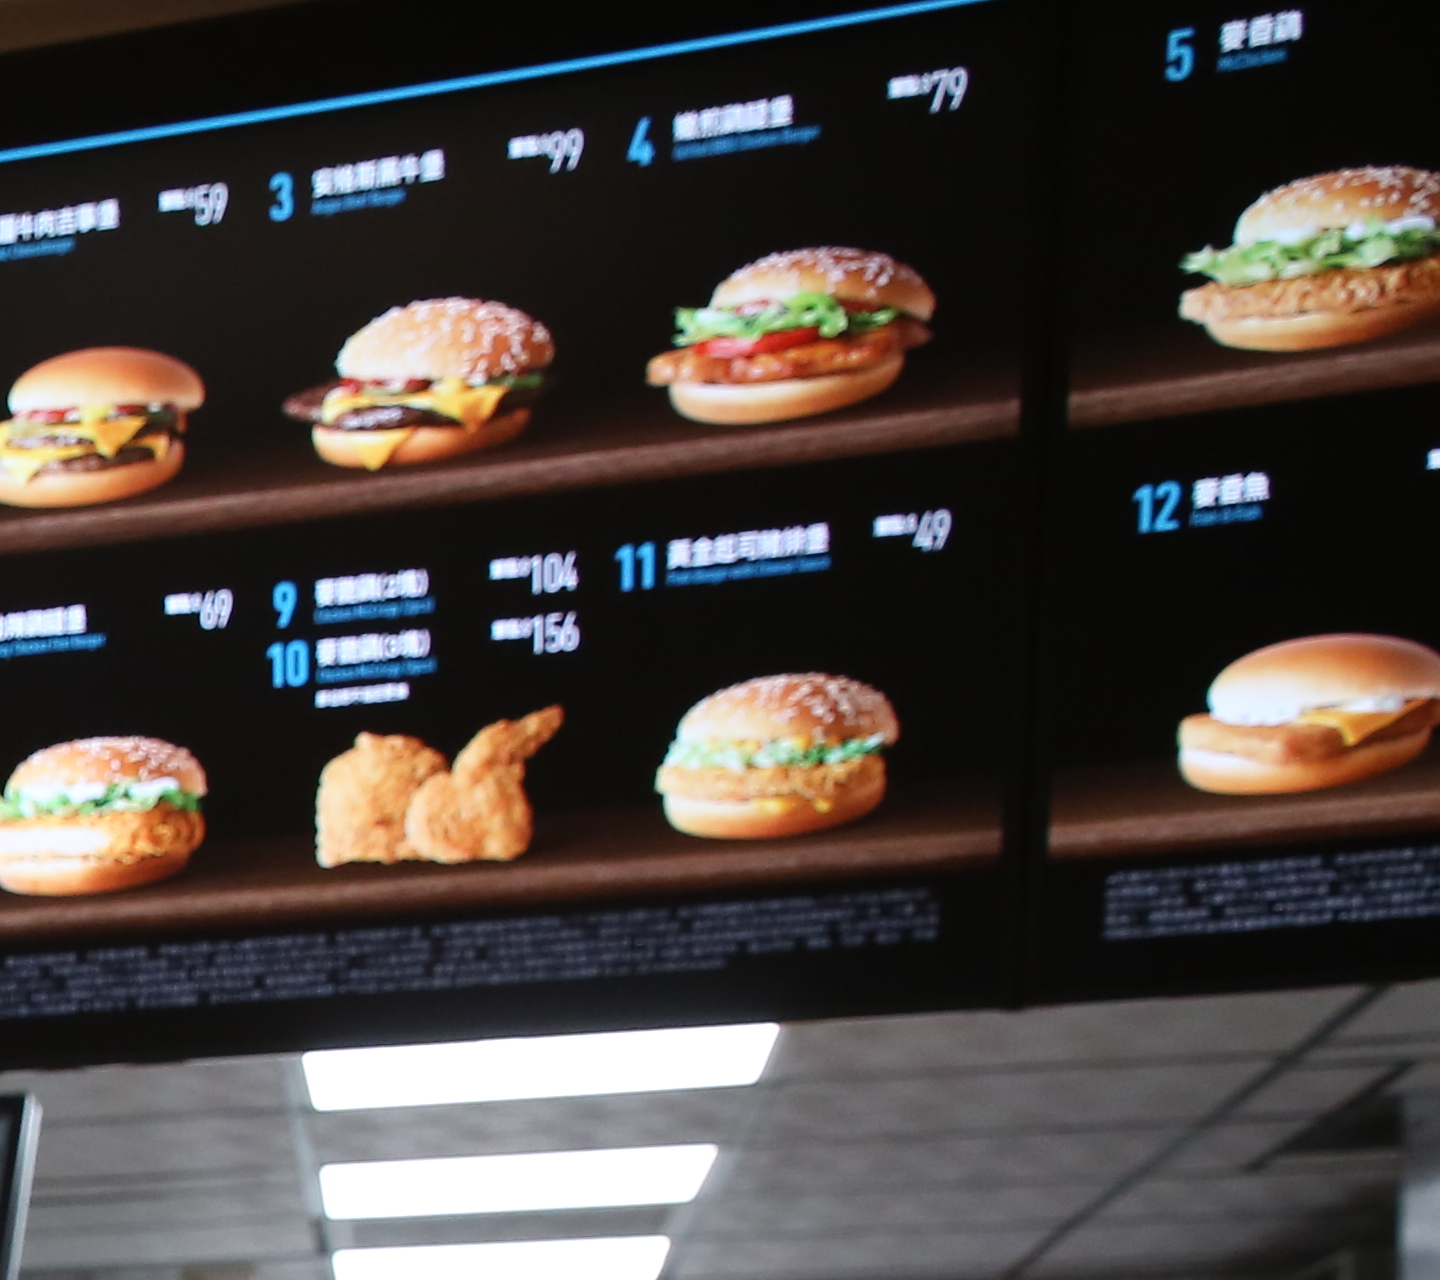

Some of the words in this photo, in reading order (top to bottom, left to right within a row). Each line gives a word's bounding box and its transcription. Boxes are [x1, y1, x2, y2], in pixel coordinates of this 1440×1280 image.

[1164, 28, 1195, 82] 5
[626, 117, 656, 167] 4
[269, 172, 295, 223] 3
[1132, 479, 1181, 535] 12
[614, 541, 656, 592] 11
[272, 581, 297, 628] 9
[266, 639, 309, 689] 10
